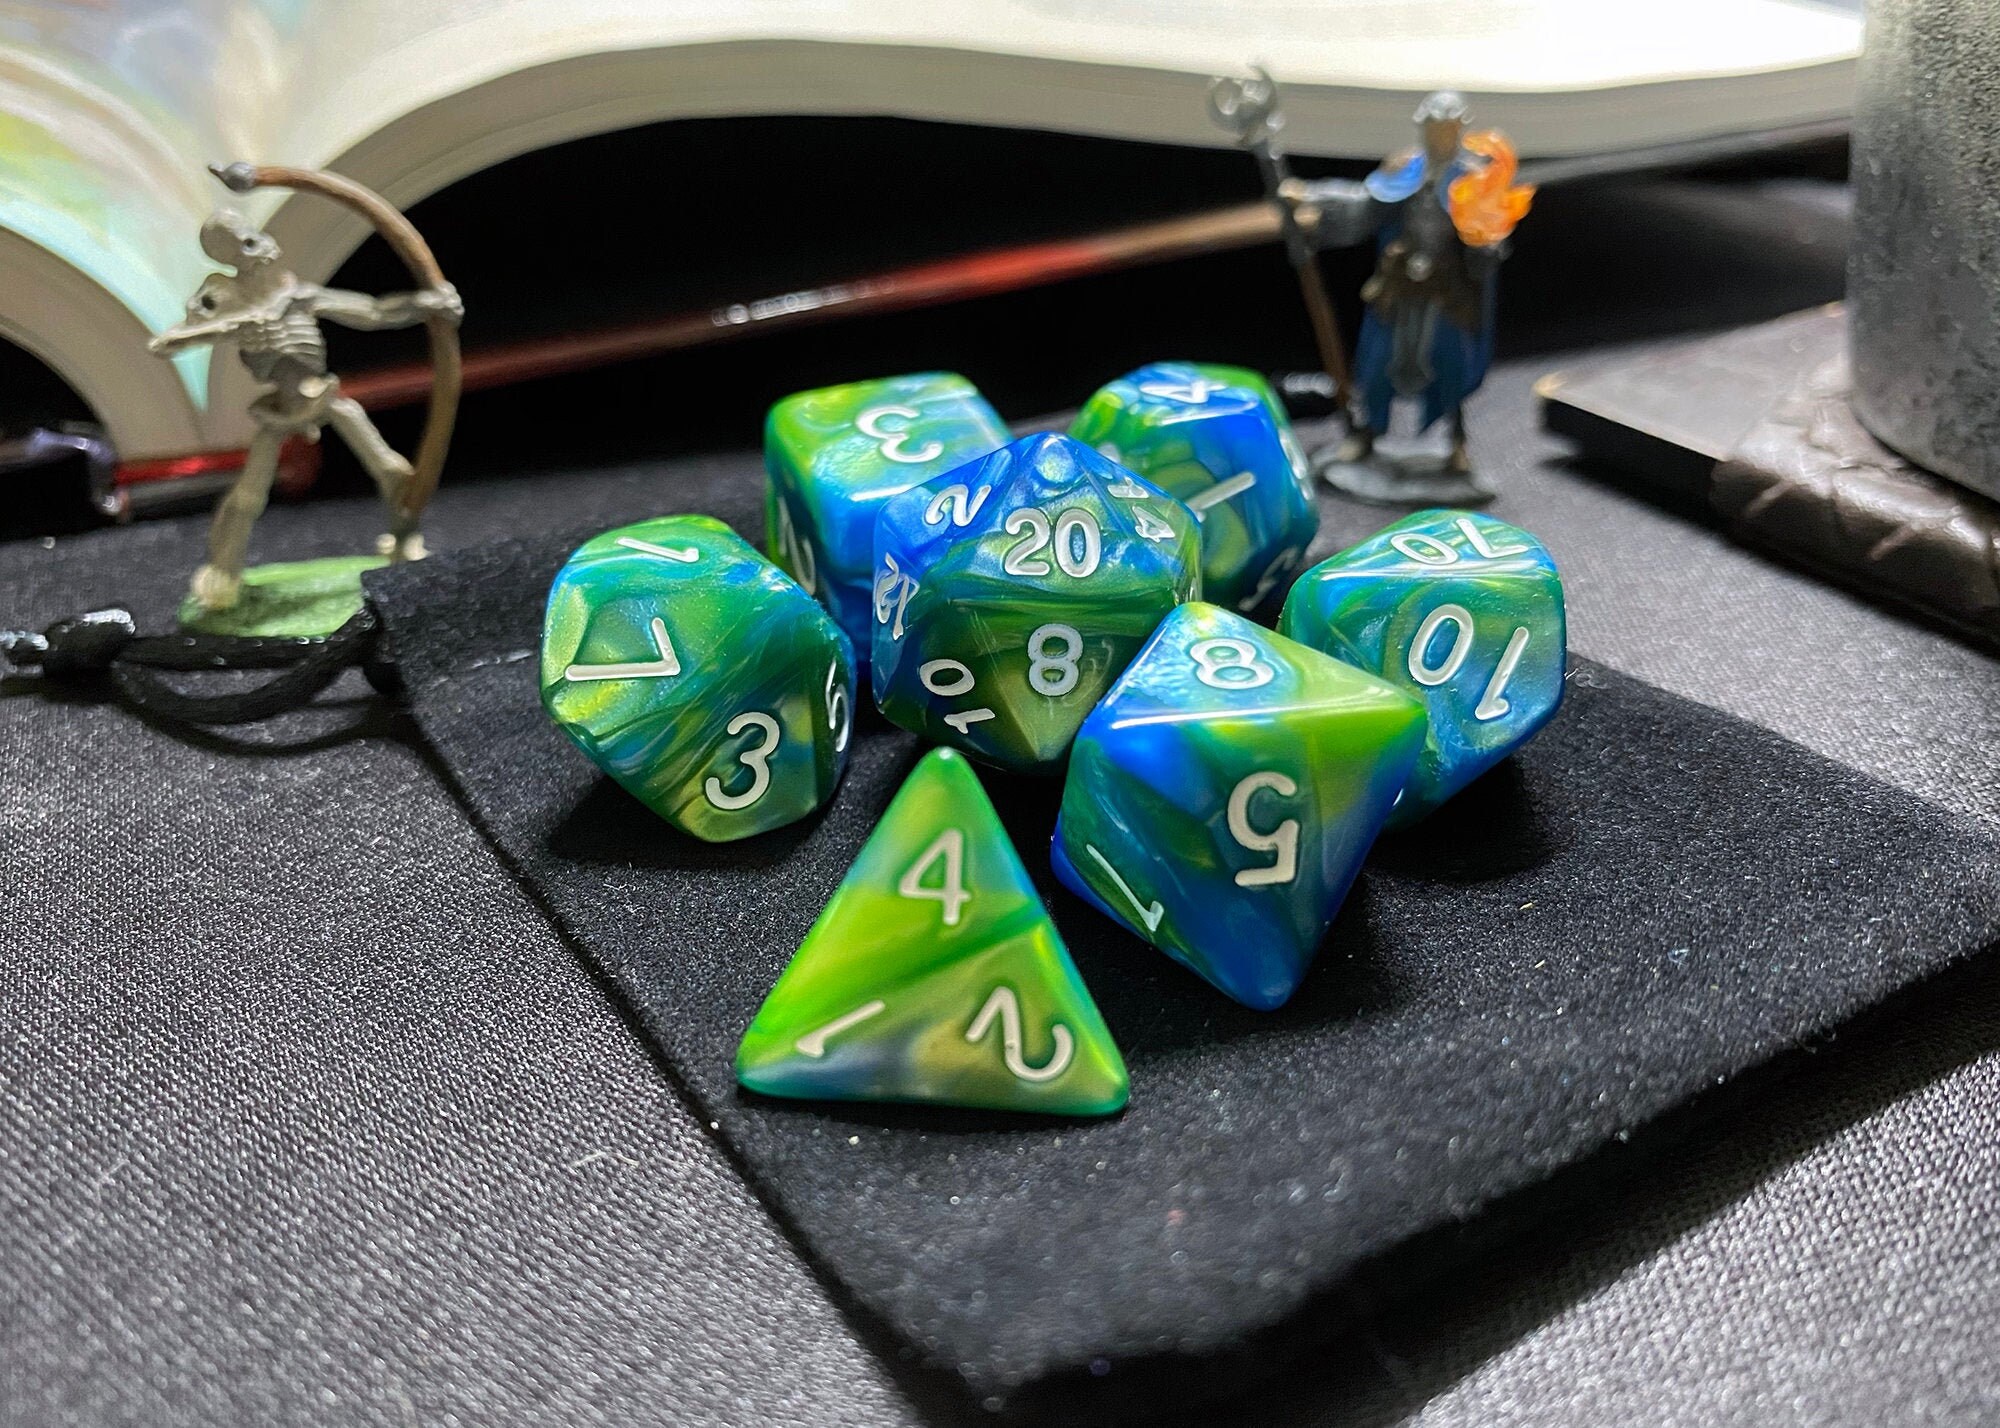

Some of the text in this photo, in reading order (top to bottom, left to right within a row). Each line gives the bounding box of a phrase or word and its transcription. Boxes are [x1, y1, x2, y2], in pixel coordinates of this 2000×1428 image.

[855, 406, 944, 463] 3
[924, 484, 992, 527] 2
[1390, 518, 1529, 566] 70
[616, 537, 699, 563] 1
[1004, 507, 1101, 578] 20
[565, 617, 681, 682] 7
[1028, 623, 1084, 696] 8
[1190, 638, 1275, 690] 8
[1408, 603, 1529, 721] 10
[825, 656, 850, 753] 5
[919, 659, 996, 734] 10
[705, 712, 780, 811] 3
[1227, 771, 1299, 887] 5
[899, 828, 972, 925] 4
[1086, 844, 1164, 932] 1
[796, 1000, 886, 1058] 1
[965, 986, 1074, 1082] 2
